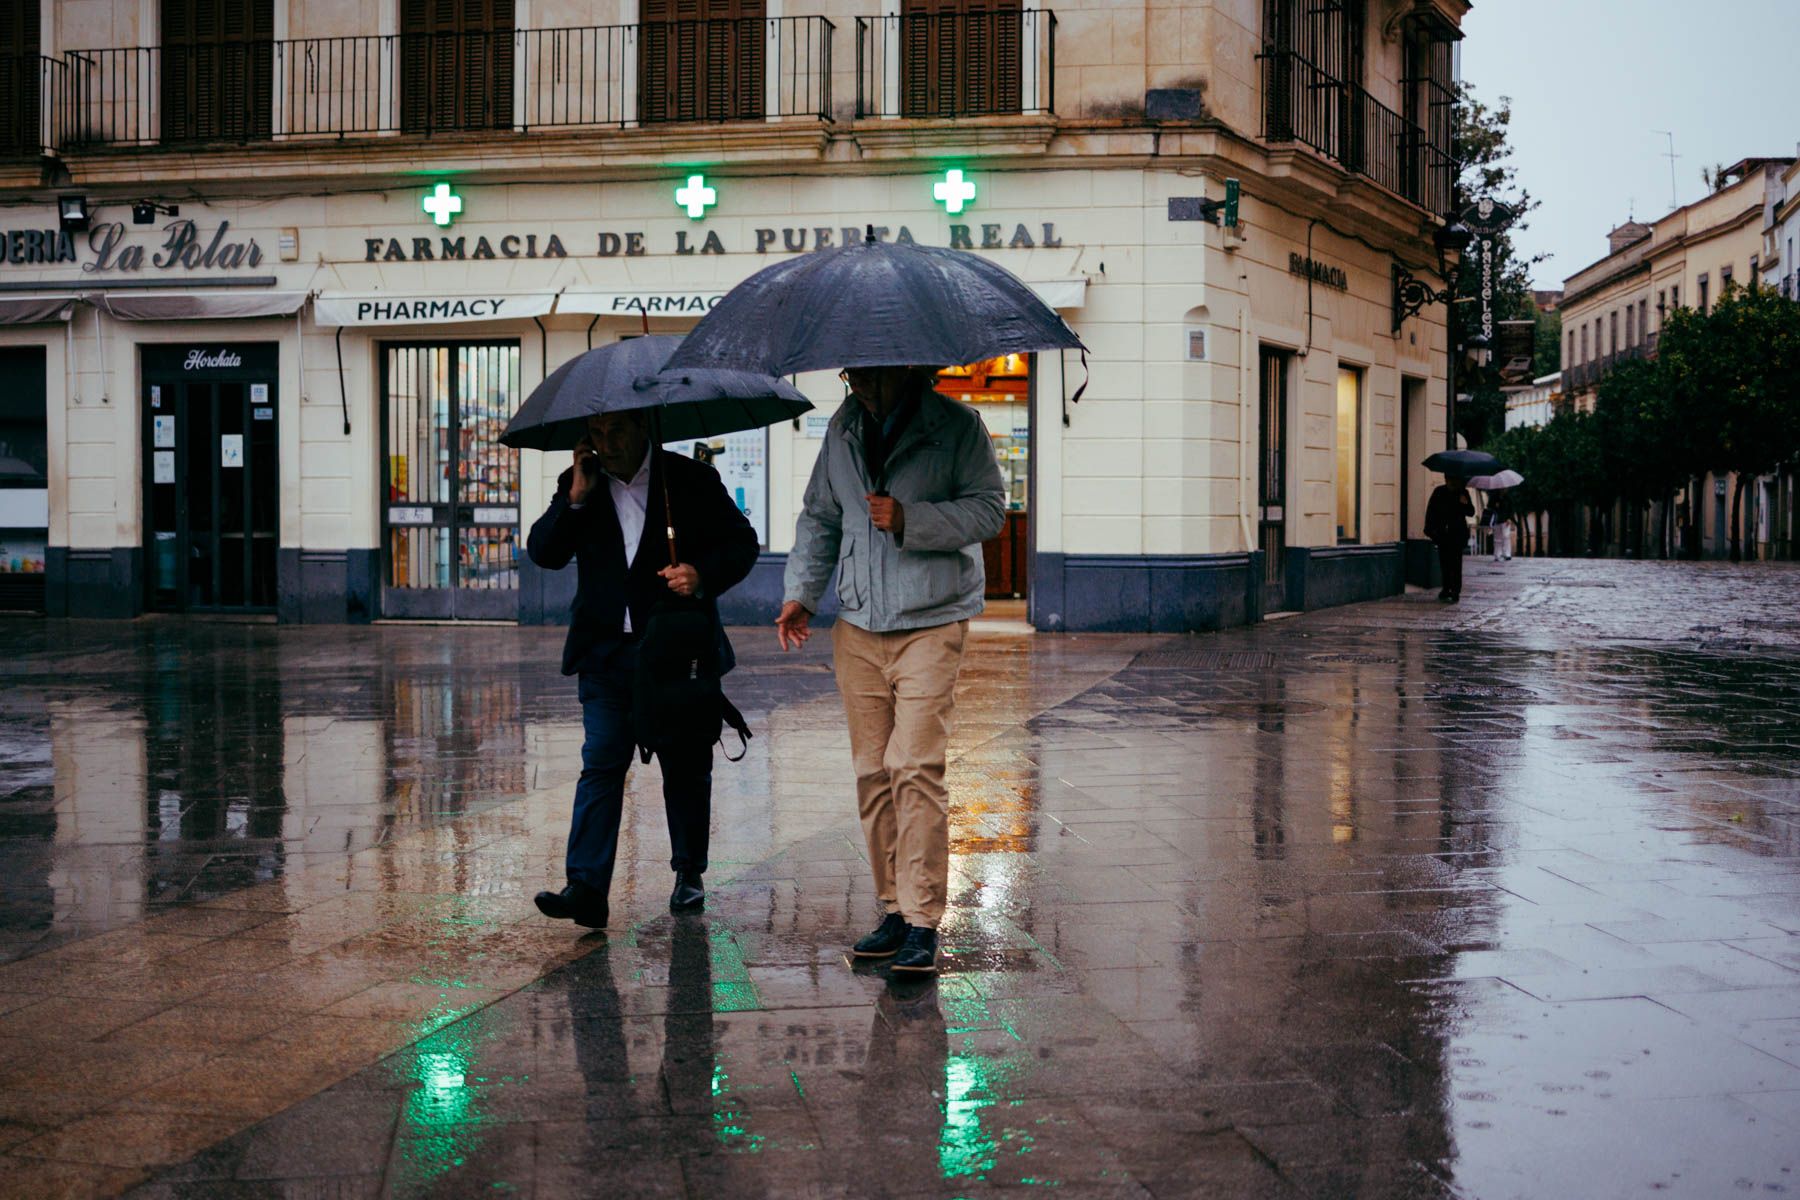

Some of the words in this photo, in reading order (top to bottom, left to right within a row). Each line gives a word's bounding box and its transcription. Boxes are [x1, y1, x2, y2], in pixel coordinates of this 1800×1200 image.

[82, 221, 144, 273] La
[153, 219, 263, 269] Polar
[365, 233, 567, 262] FARMACIA
[597, 231, 646, 257] DE
[675, 230, 725, 256] LA
[949, 223, 1062, 250] REAL
[357, 299, 505, 320] PHARMACY
[184, 349, 241, 370] Horchata
